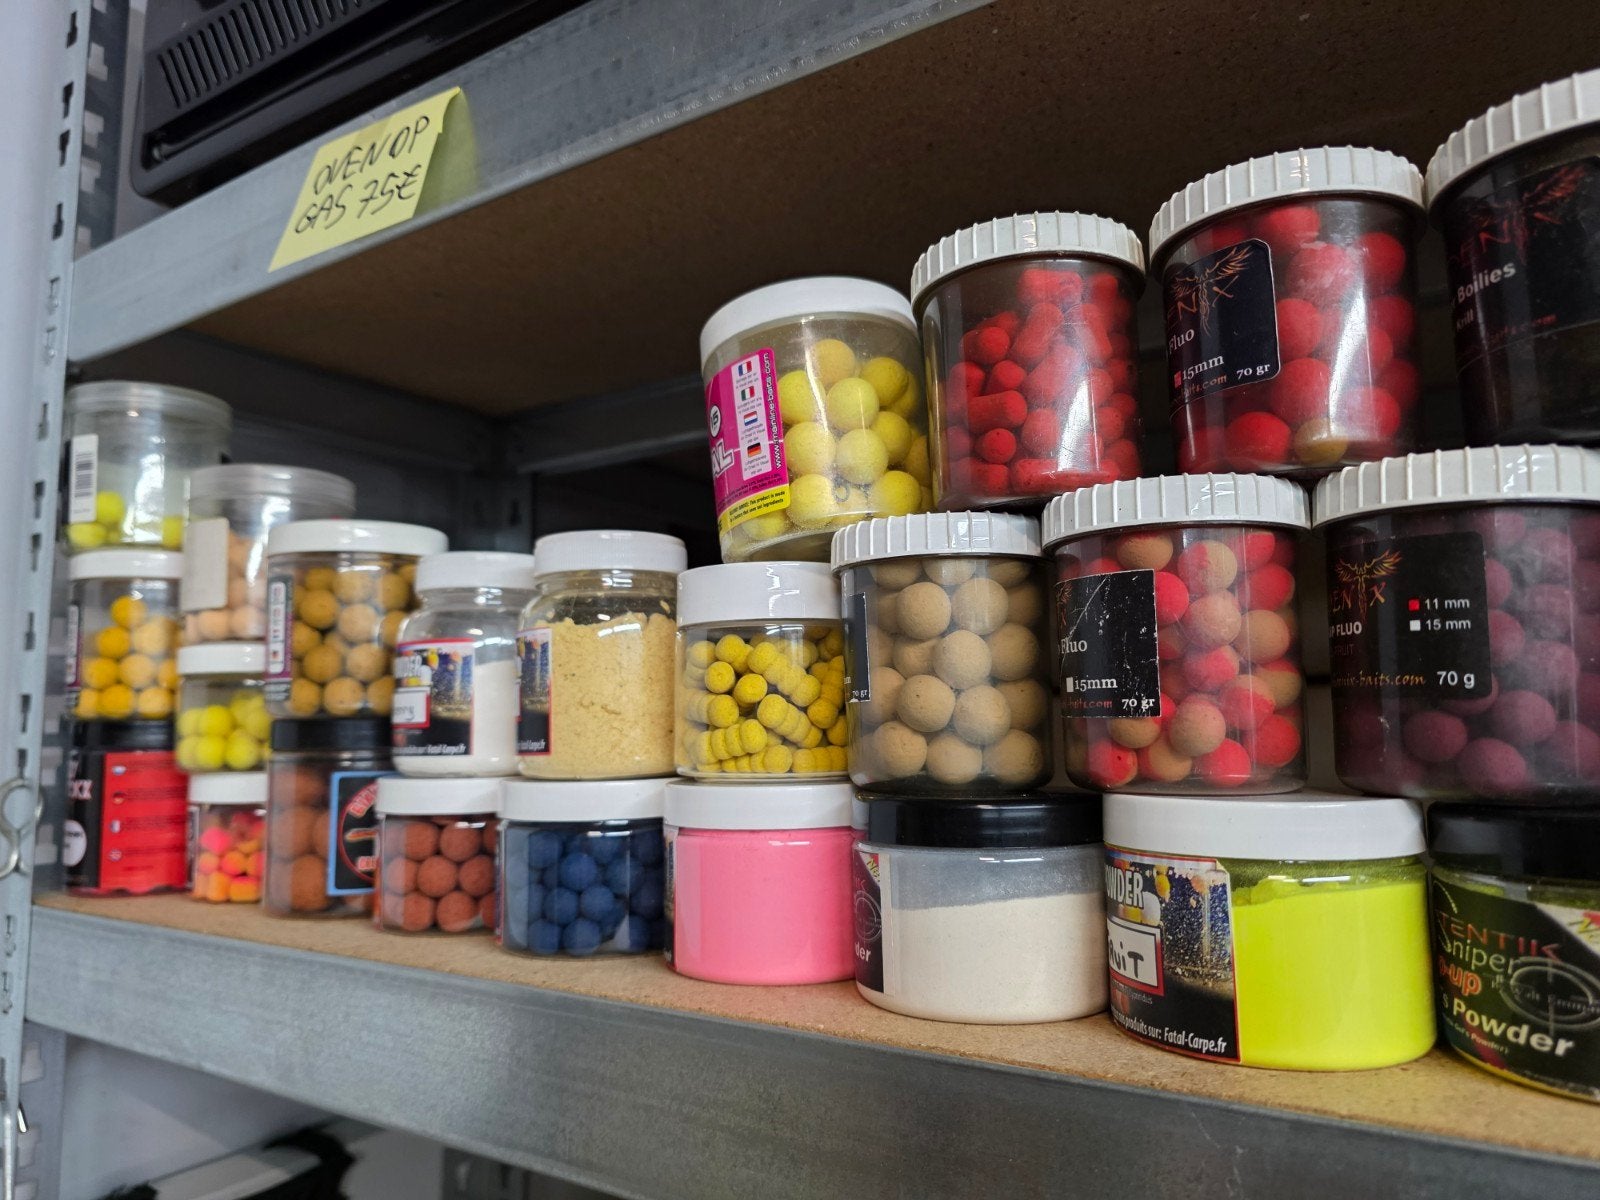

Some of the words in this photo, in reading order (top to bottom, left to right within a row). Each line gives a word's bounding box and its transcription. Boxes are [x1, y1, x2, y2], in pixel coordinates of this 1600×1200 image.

[313, 133, 391, 195] OVEN
[389, 116, 429, 159] OP
[295, 185, 352, 233] GAS
[1457, 262, 1516, 303] Boilies
[1182, 355, 1224, 381] 15mm
[1236, 367, 1253, 380] 70
[1256, 363, 1271, 376] gr
[763, 353, 782, 469] www.mainline-baits.com
[1425, 598, 1439, 610] 11
[1444, 598, 1470, 609] mm
[1336, 621, 1362, 636] FLUO
[1426, 619, 1442, 631] 15
[1445, 619, 1471, 630] mm
[1060, 640, 1088, 654] Fluo
[1074, 676, 1118, 692] 15mm
[1437, 671, 1459, 686] 70
[1463, 673, 1475, 690] g
[1122, 699, 1138, 710] 70
[1141, 697, 1155, 712] gr
[1452, 997, 1576, 1057] Powder
[1148, 1024, 1162, 1040] sur:
[1164, 1027, 1228, 1054] Fatal-Carpe.fr
